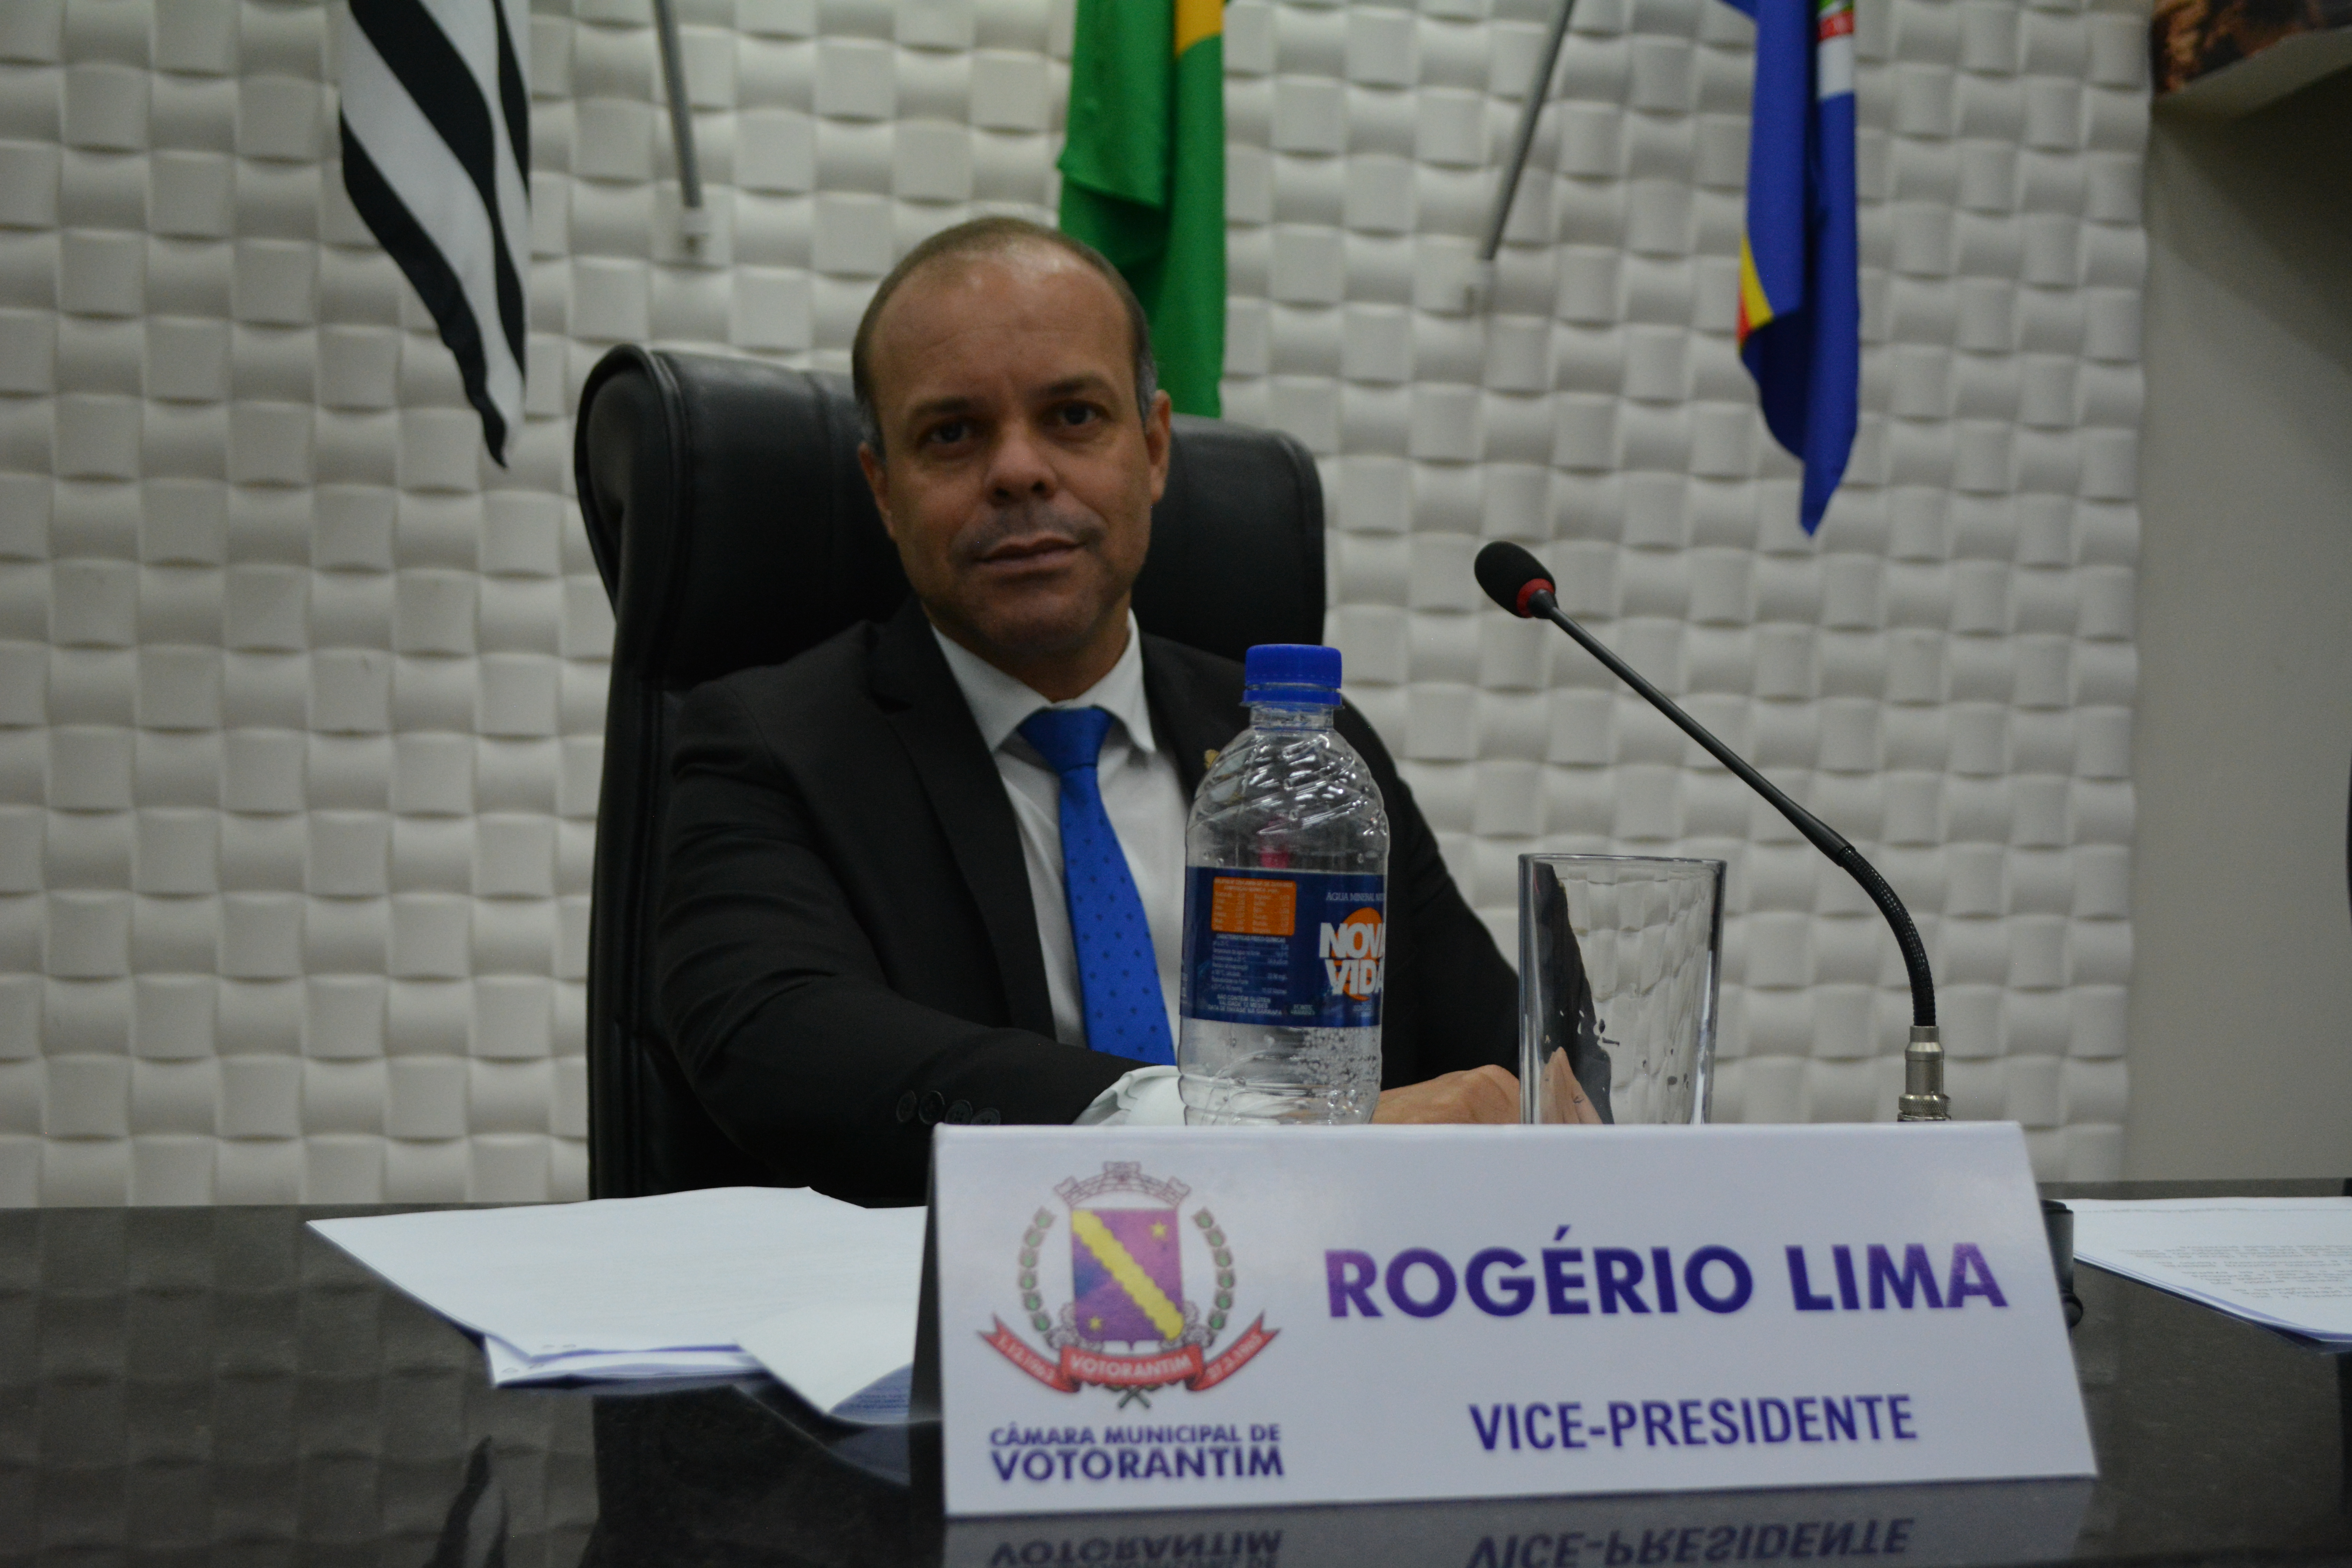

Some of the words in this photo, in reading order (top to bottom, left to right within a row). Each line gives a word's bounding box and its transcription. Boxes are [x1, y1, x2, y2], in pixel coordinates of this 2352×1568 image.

[1326, 890, 1348, 901] ÁGUA
[1350, 893, 1374, 901] MINERAL
[1325, 1225, 1755, 1319] ROGÉRIO
[1784, 1243, 2009, 1312] LIMA
[1069, 1353, 1193, 1379] VOTORANTIM
[990, 1422, 1096, 1446] CÂMARA
[1104, 1425, 1241, 1444] MUNICIPAL
[1250, 1424, 1281, 1442] DE
[1469, 1394, 1918, 1451] VICE-PRESIDENTE
[990, 1446, 1284, 1481] VOTORANTIM
